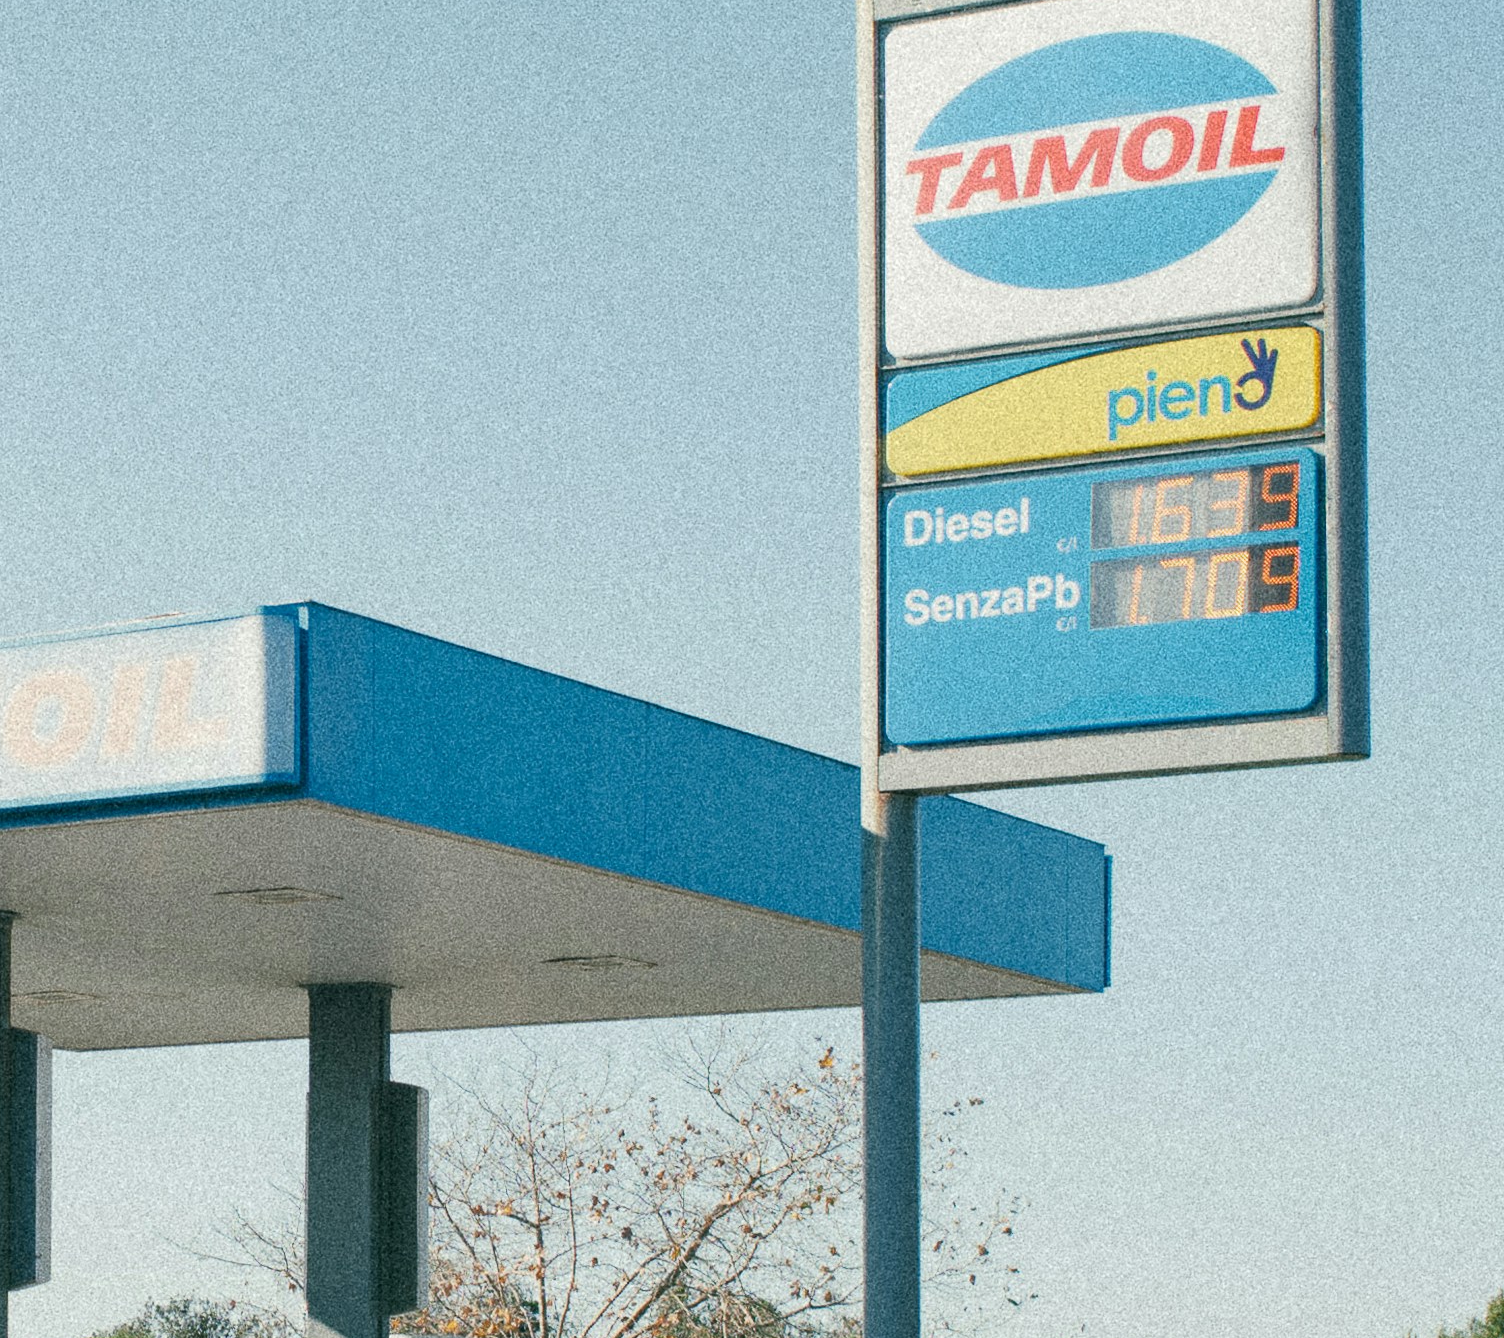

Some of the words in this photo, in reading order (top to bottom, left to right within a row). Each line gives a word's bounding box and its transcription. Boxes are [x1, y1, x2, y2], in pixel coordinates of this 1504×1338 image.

[905, 105, 1286, 216] TAMOIL
[903, 498, 1031, 548] Diesel
[903, 573, 1081, 625] SenzaPb
